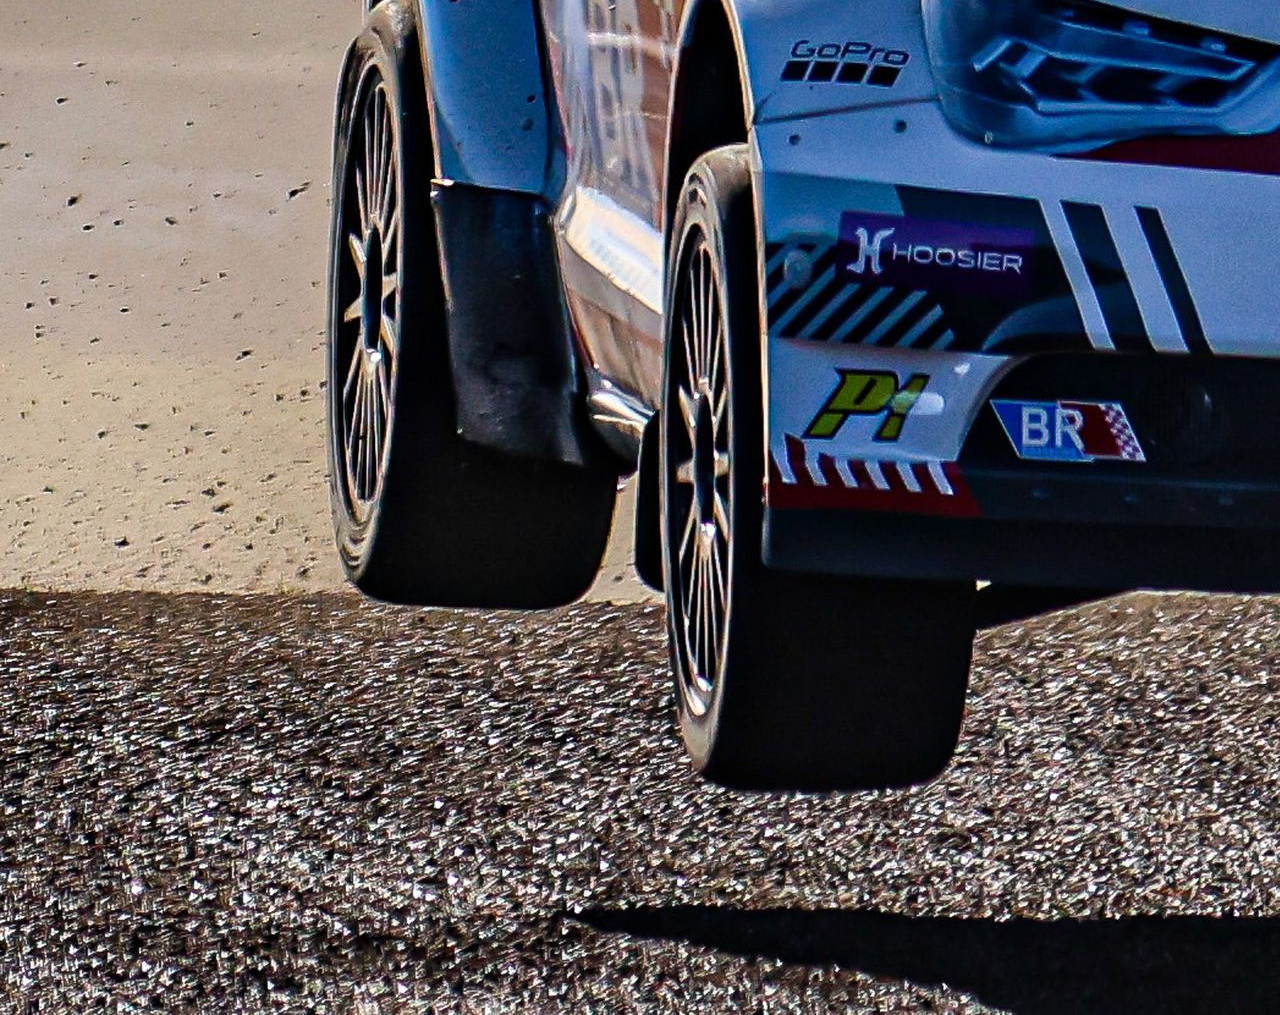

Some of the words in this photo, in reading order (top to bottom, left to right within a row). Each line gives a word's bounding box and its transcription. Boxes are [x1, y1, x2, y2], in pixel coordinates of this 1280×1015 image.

[790, 39, 910, 66] GoPro
[891, 242, 1023, 275] HOOSIER
[1020, 407, 1086, 451] BR
